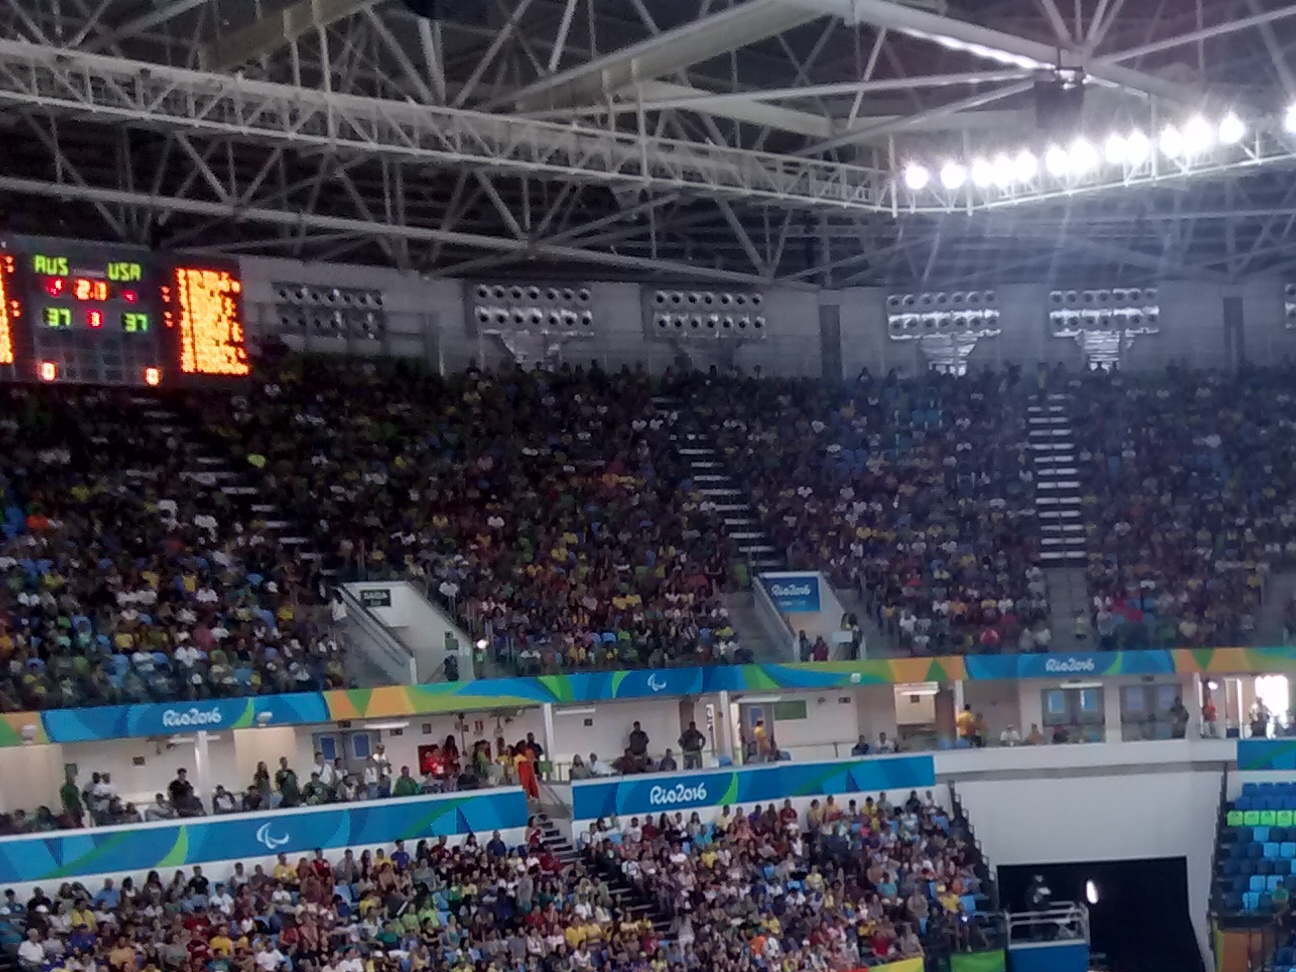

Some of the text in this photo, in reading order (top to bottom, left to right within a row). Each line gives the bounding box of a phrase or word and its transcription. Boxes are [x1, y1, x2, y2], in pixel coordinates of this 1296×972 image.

[34, 254, 69, 276] AUS
[108, 262, 142, 281] USA
[47, 307, 71, 327] 37
[124, 312, 148, 332] 37
[1046, 657, 1095, 672] Rio2016
[163, 706, 222, 728] Rio2016
[650, 781, 707, 805] Rio2016
